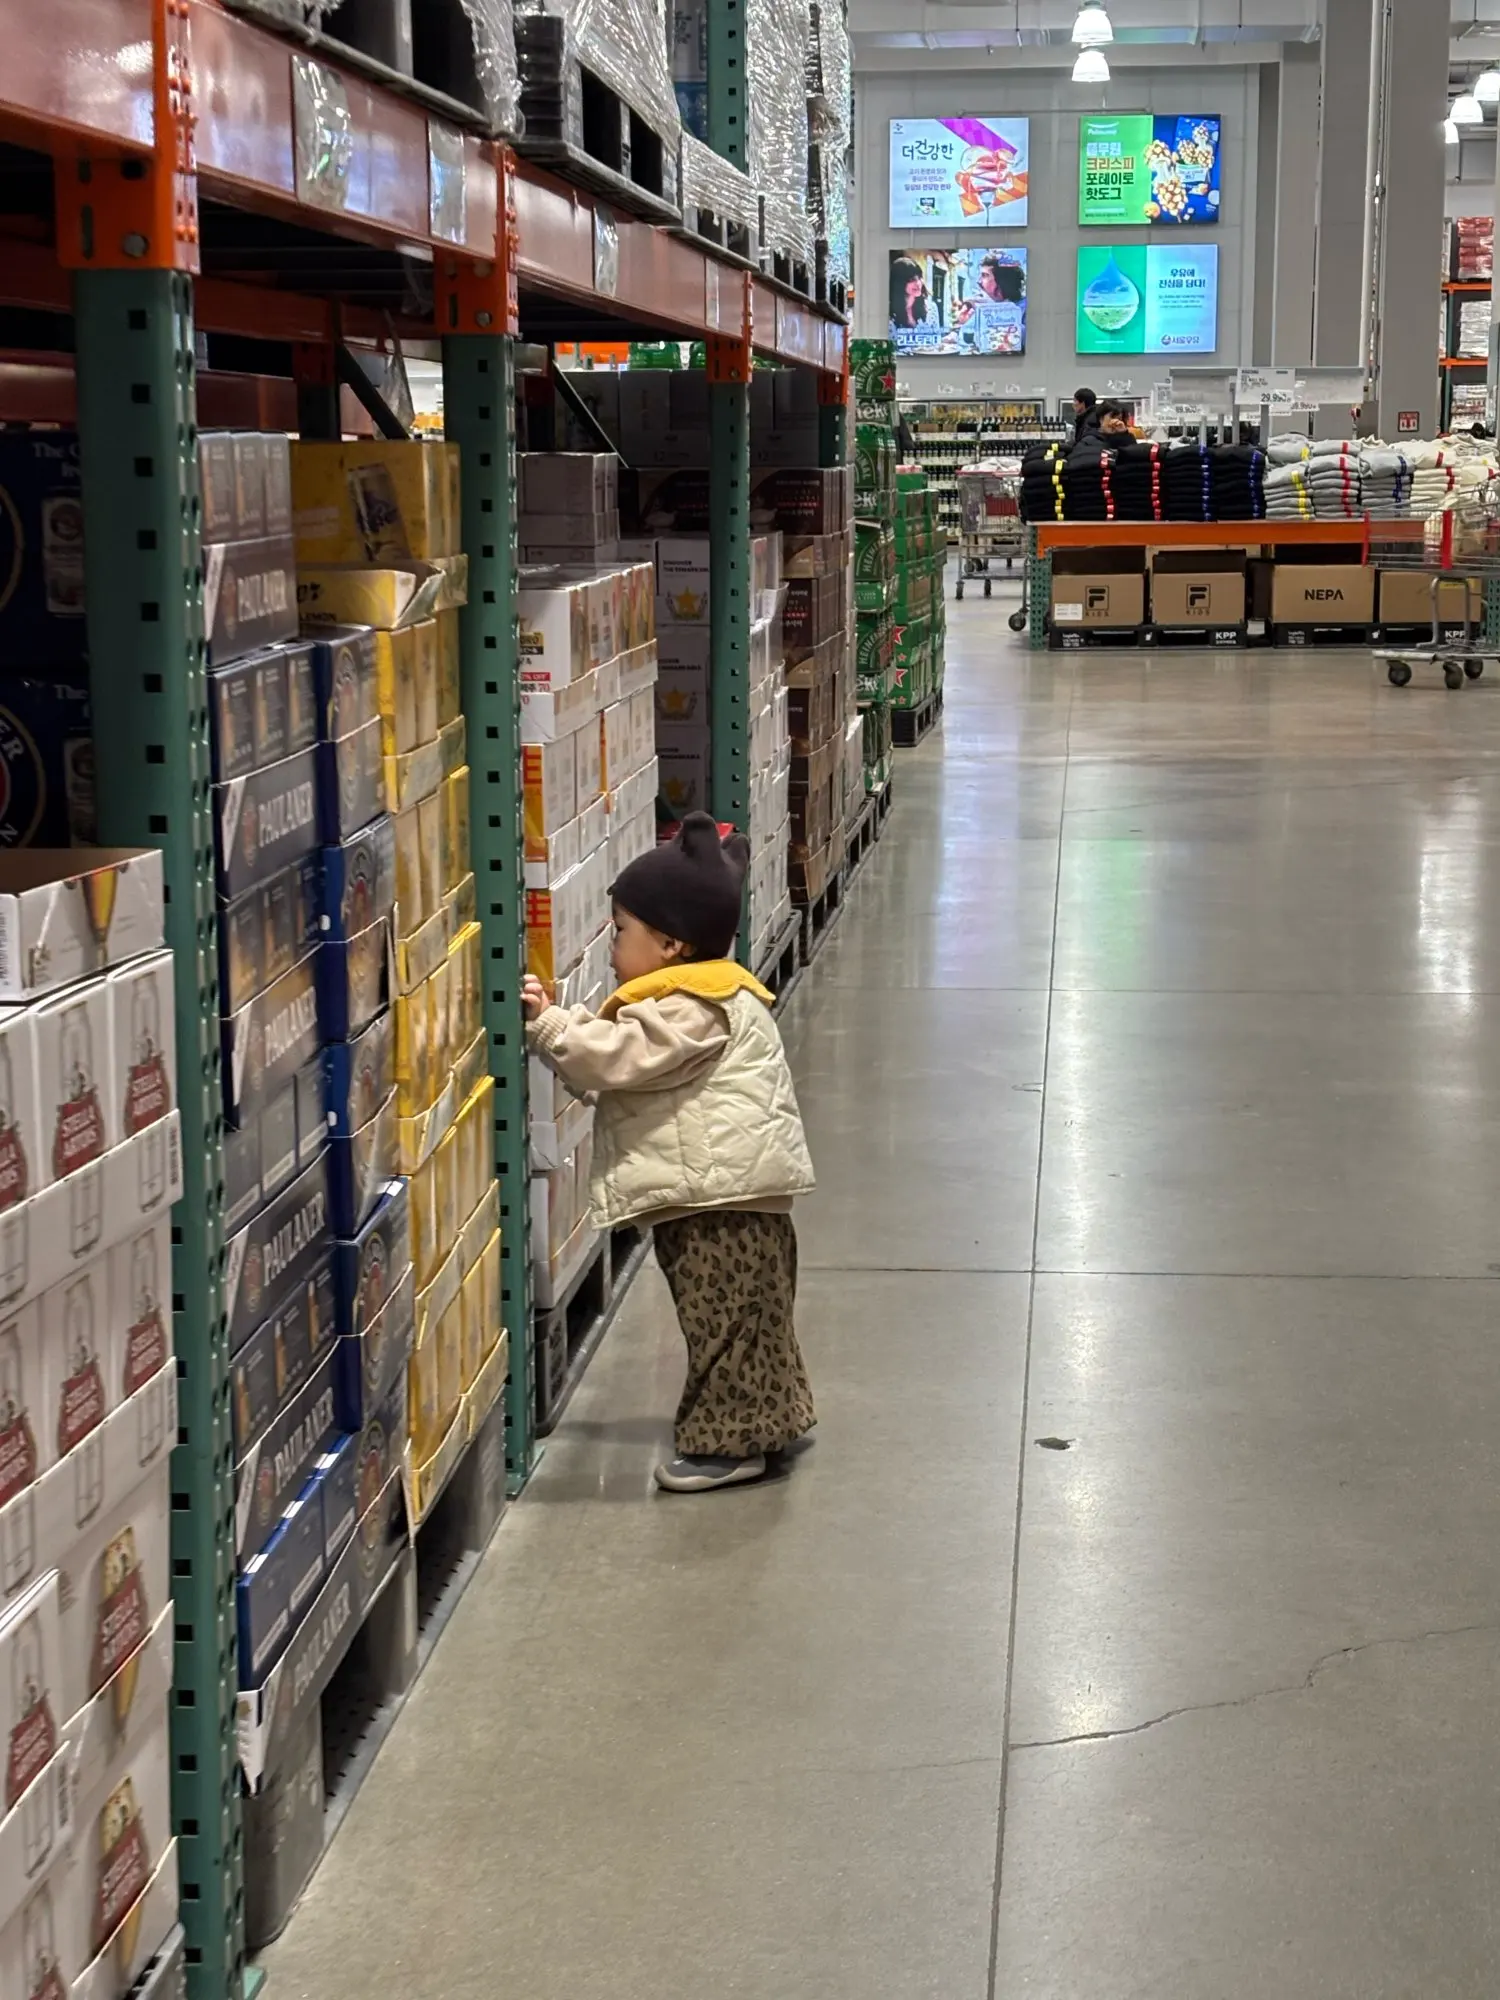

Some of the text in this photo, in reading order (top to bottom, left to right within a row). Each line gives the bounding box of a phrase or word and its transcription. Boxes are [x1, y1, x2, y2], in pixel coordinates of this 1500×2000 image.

[1087, 157, 1134, 170] 크리스피
[1086, 187, 1122, 201] 핫도그
[1304, 589, 1344, 600] NEPA
[1215, 631, 1236, 640] KPP
[259, 781, 314, 848] PAULANER
[263, 1191, 325, 1287] PAULANER
[275, 1386, 334, 1497] PAULANER
[294, 1582, 351, 1707] PAULANER
